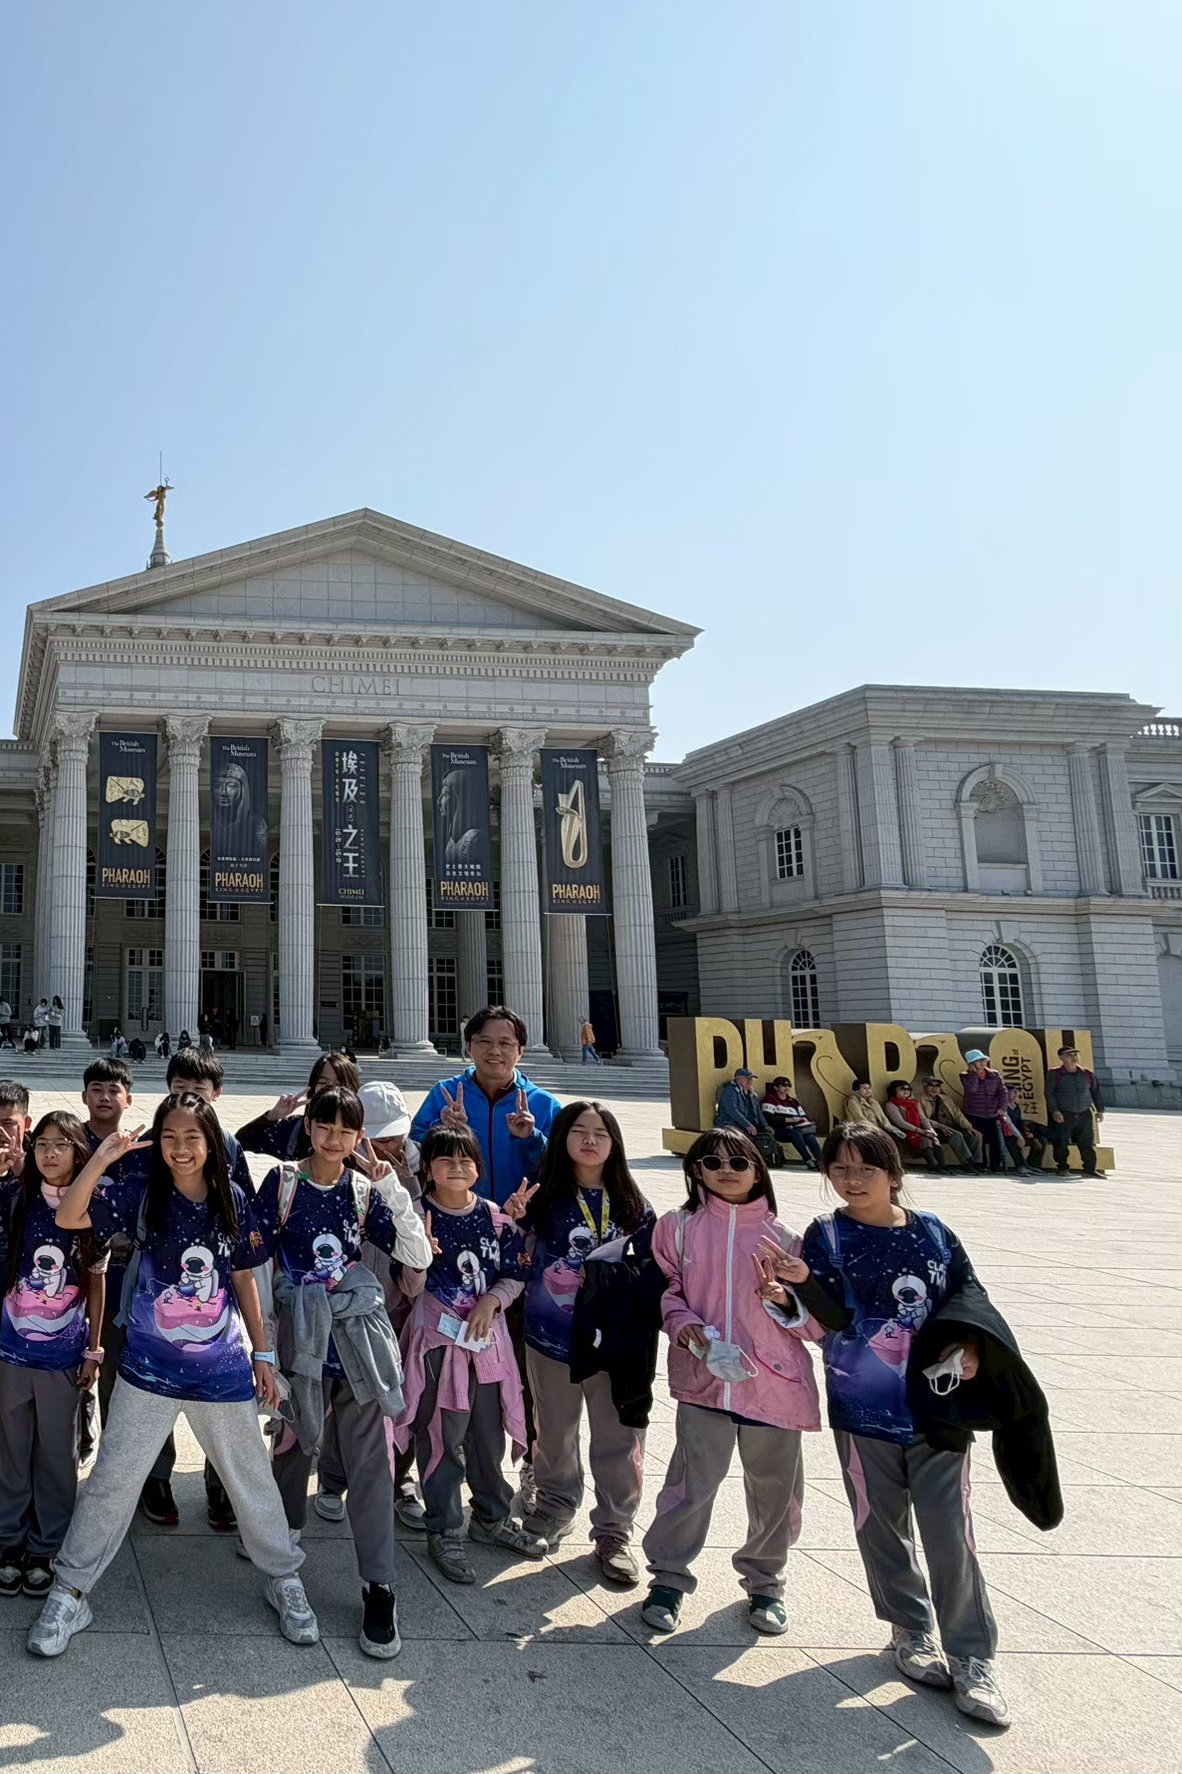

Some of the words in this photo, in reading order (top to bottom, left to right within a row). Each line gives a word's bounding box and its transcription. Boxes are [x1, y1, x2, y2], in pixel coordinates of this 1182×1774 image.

[311, 675, 401, 696] CHIMEI
[102, 867, 150, 884] PHARAOH
[215, 872, 263, 888] PHARAOH
[440, 881, 488, 897] PHARAOH
[552, 883, 600, 900] PHARAOH
[1021, 1057, 1034, 1099] EGYPT
[1022, 1101, 1039, 1115] 之王
